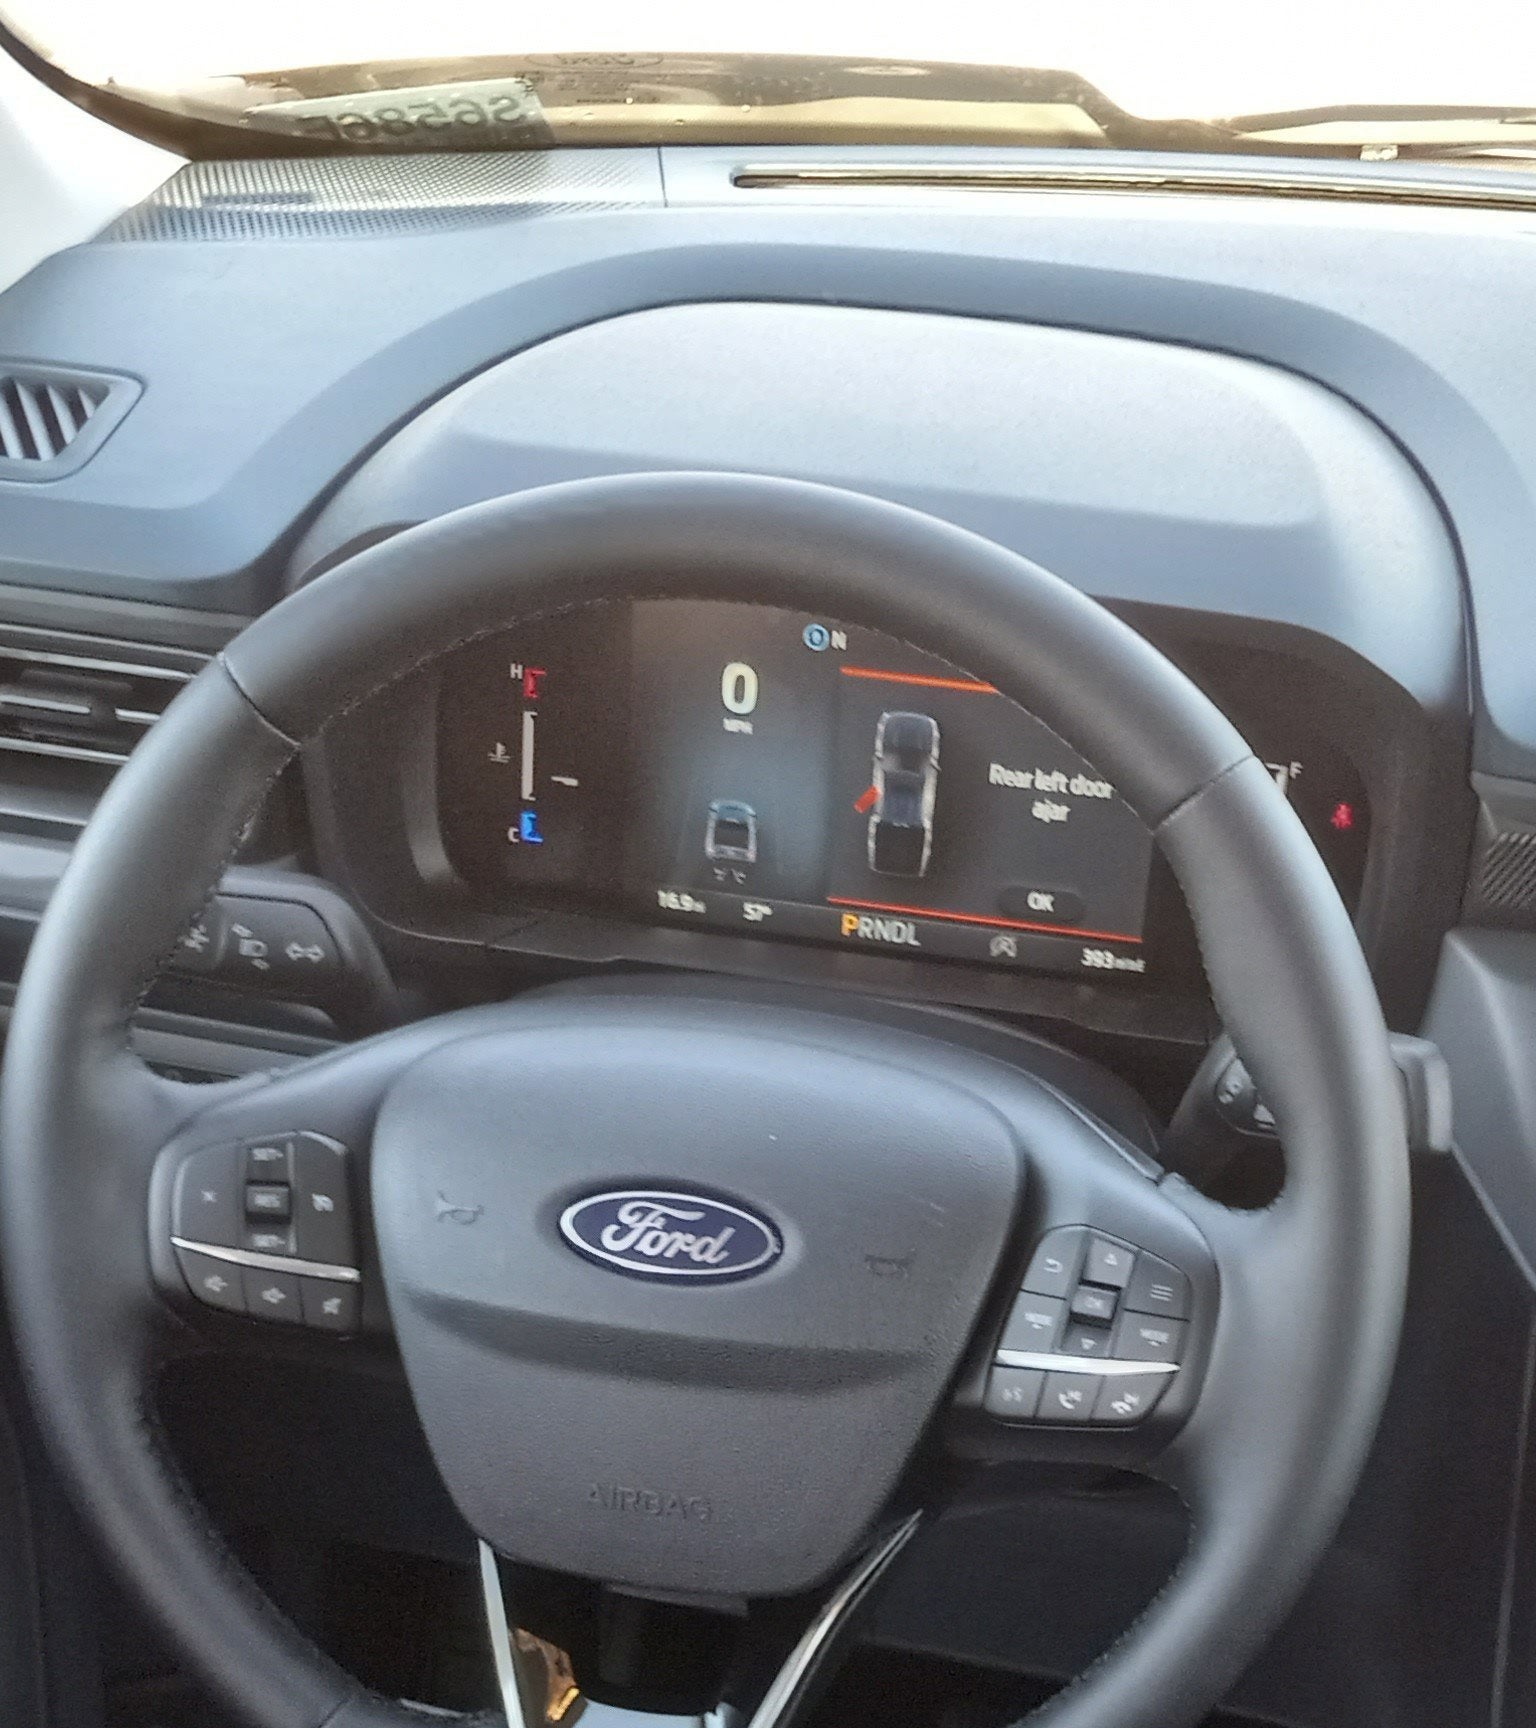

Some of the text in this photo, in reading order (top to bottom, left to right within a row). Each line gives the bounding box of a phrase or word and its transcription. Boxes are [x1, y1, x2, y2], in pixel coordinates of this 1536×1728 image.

[721, 661, 759, 715] 0
[989, 763, 1116, 799] Rear left door
[1032, 799, 1070, 823] ajar
[1027, 891, 1055, 912] OK
[600, 1199, 737, 1267] Ford
